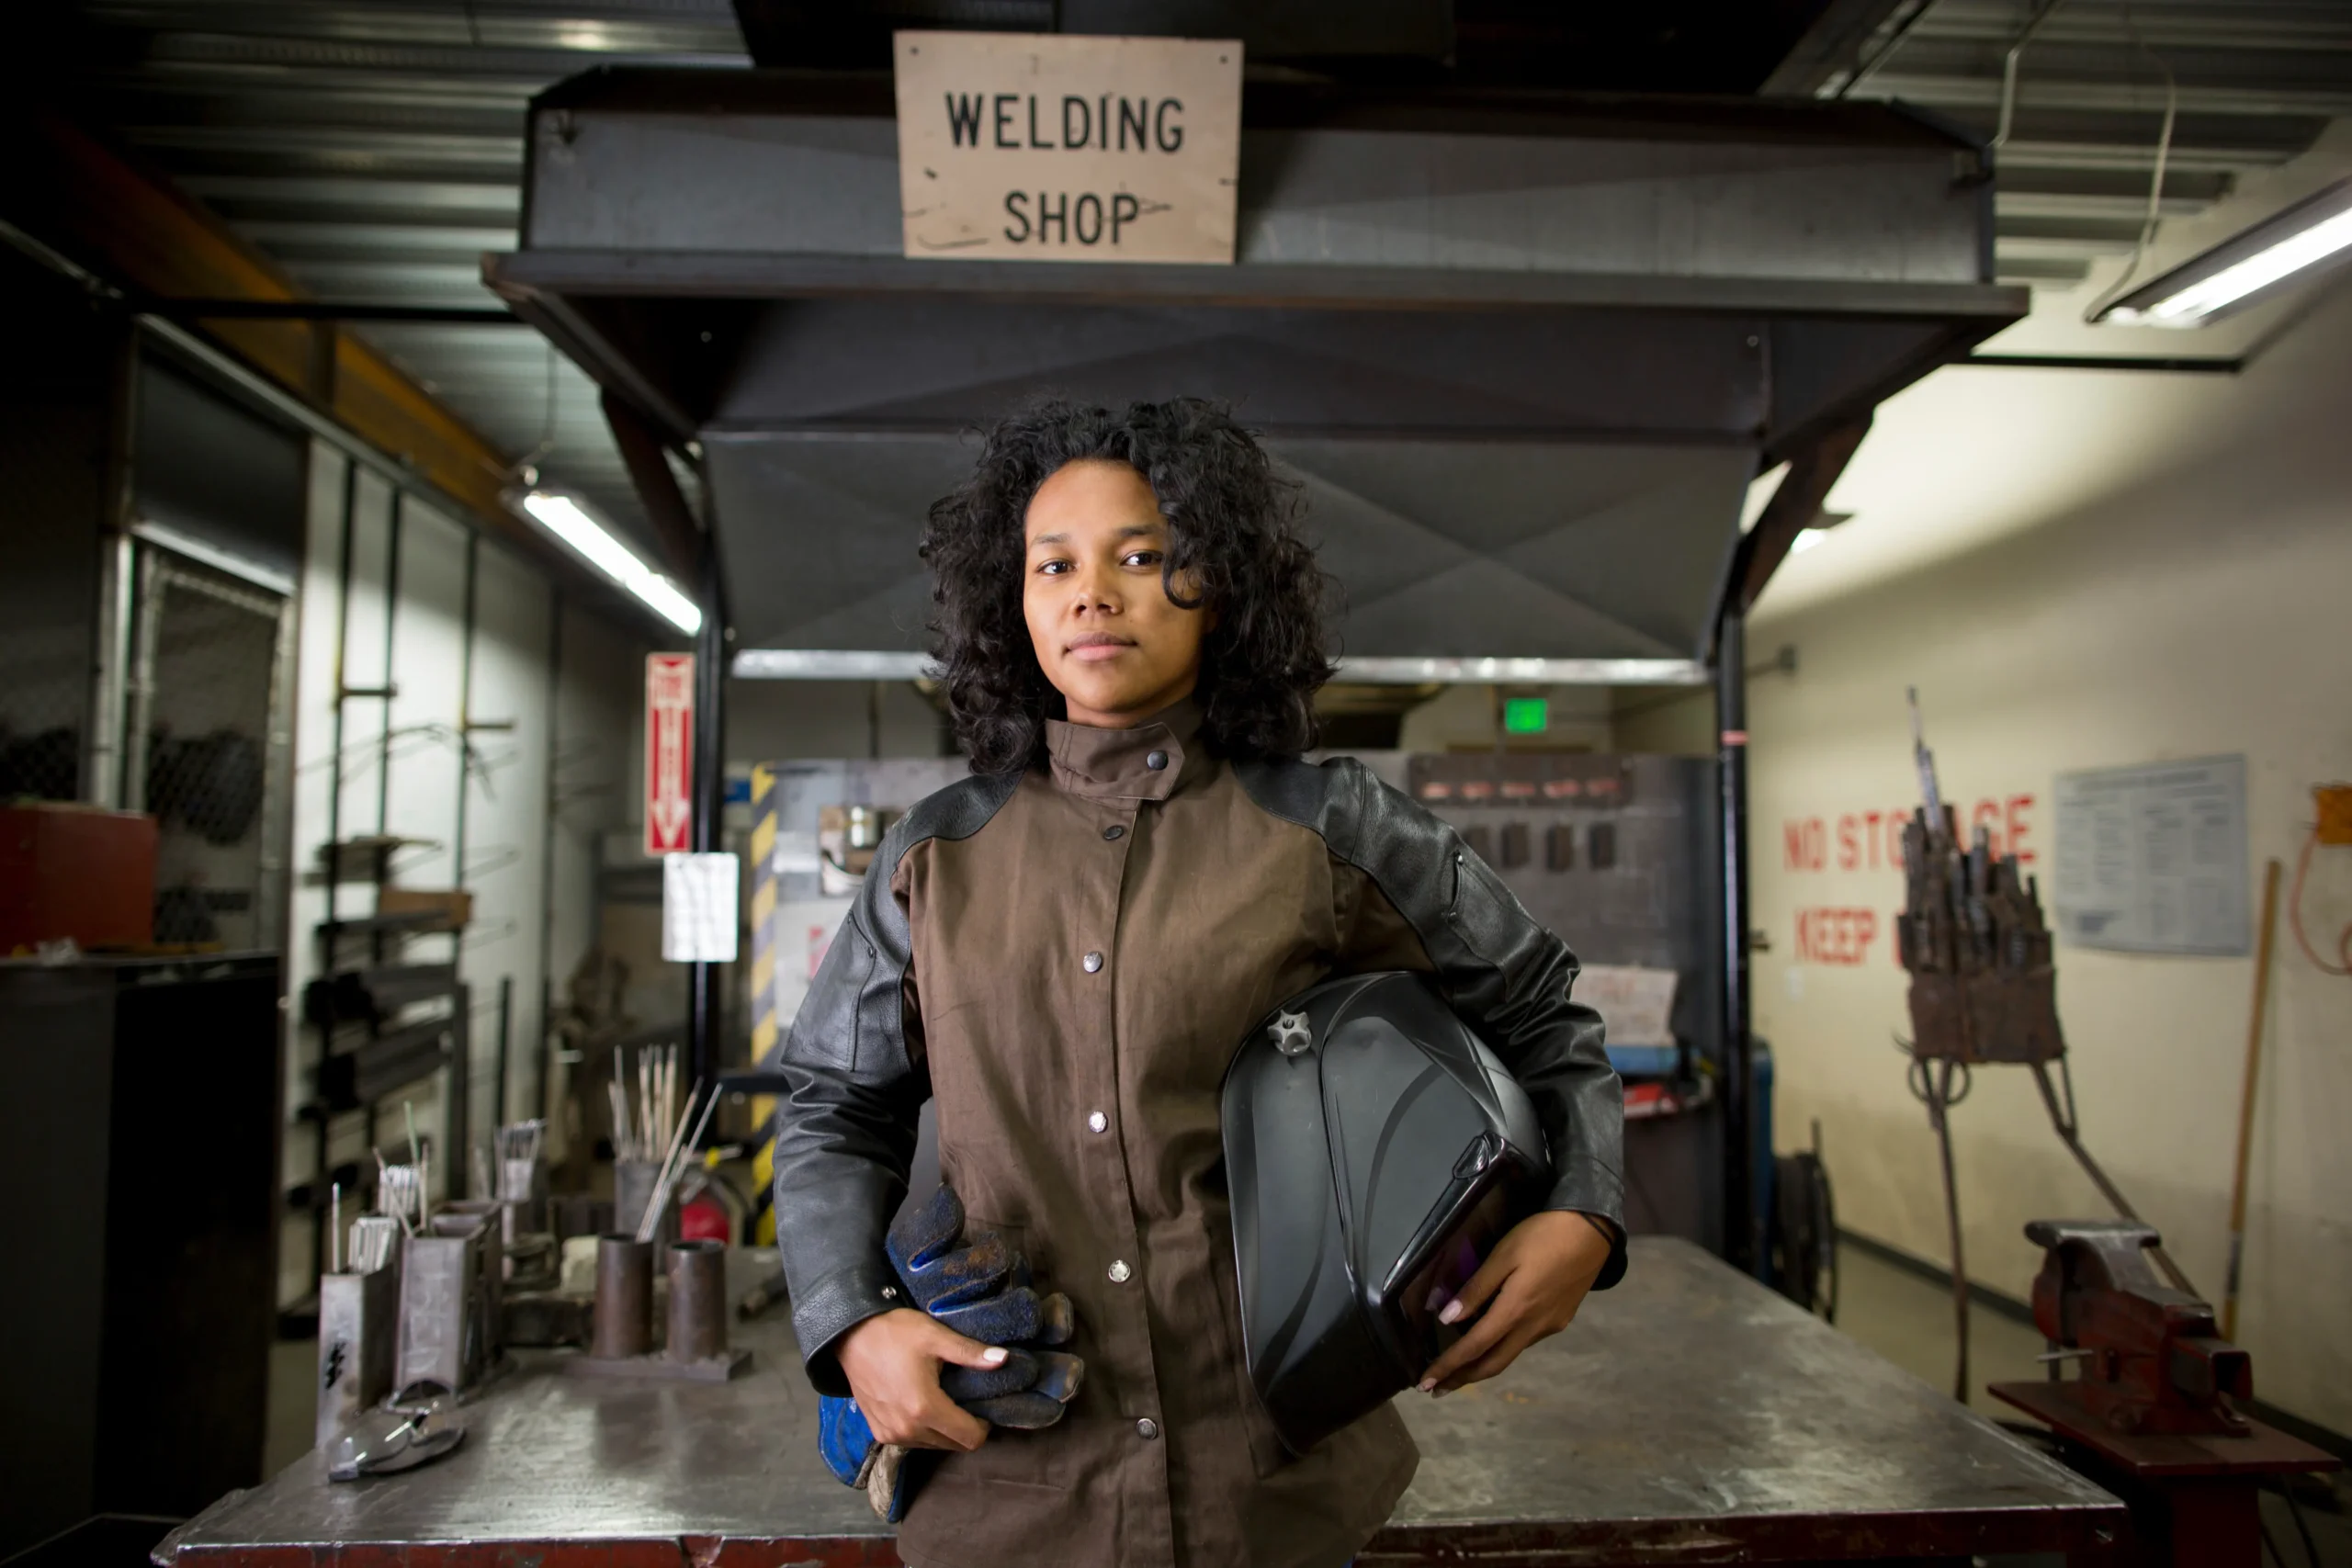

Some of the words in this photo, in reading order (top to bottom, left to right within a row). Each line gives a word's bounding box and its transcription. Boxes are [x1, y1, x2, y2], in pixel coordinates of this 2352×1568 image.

[945, 93, 1184, 152] WELDING
[1003, 190, 1138, 245] SHOP
[1783, 818, 1826, 870] NO
[1795, 906, 1878, 965] KEEP
